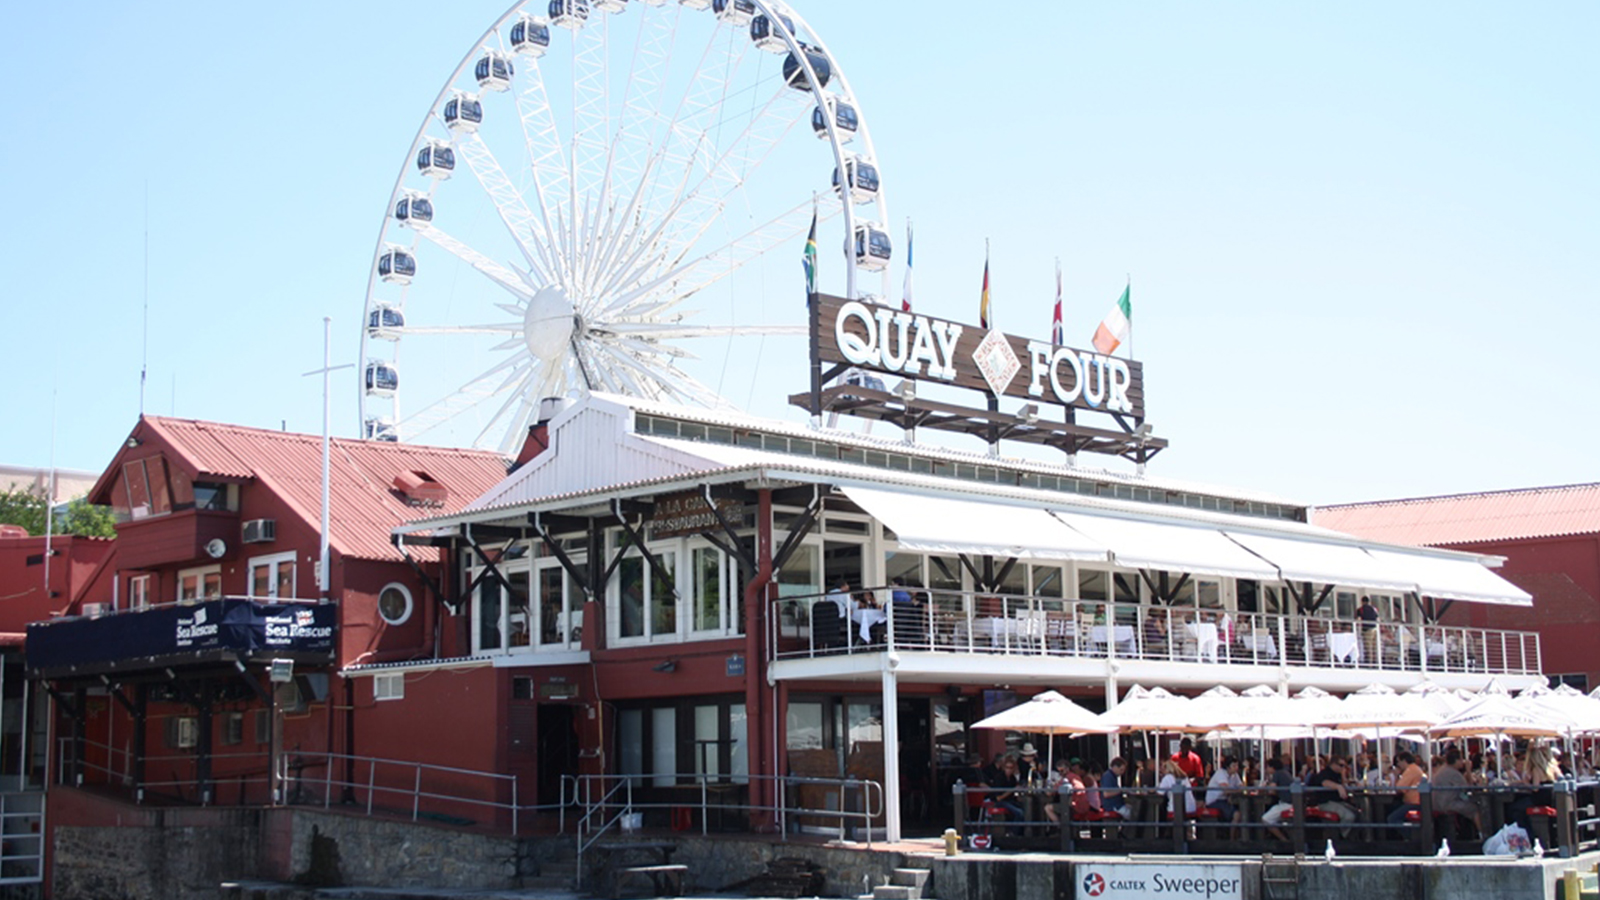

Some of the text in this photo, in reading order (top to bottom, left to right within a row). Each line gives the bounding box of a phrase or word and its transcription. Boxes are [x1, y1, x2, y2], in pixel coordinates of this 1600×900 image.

[836, 301, 963, 381] QUAY
[1027, 339, 1133, 413] FOUR
[176, 624, 218, 638] Sea Rescue
[265, 623, 332, 637] Sea Rescue
[1110, 873, 1239, 899] CALTEX Sweeper
